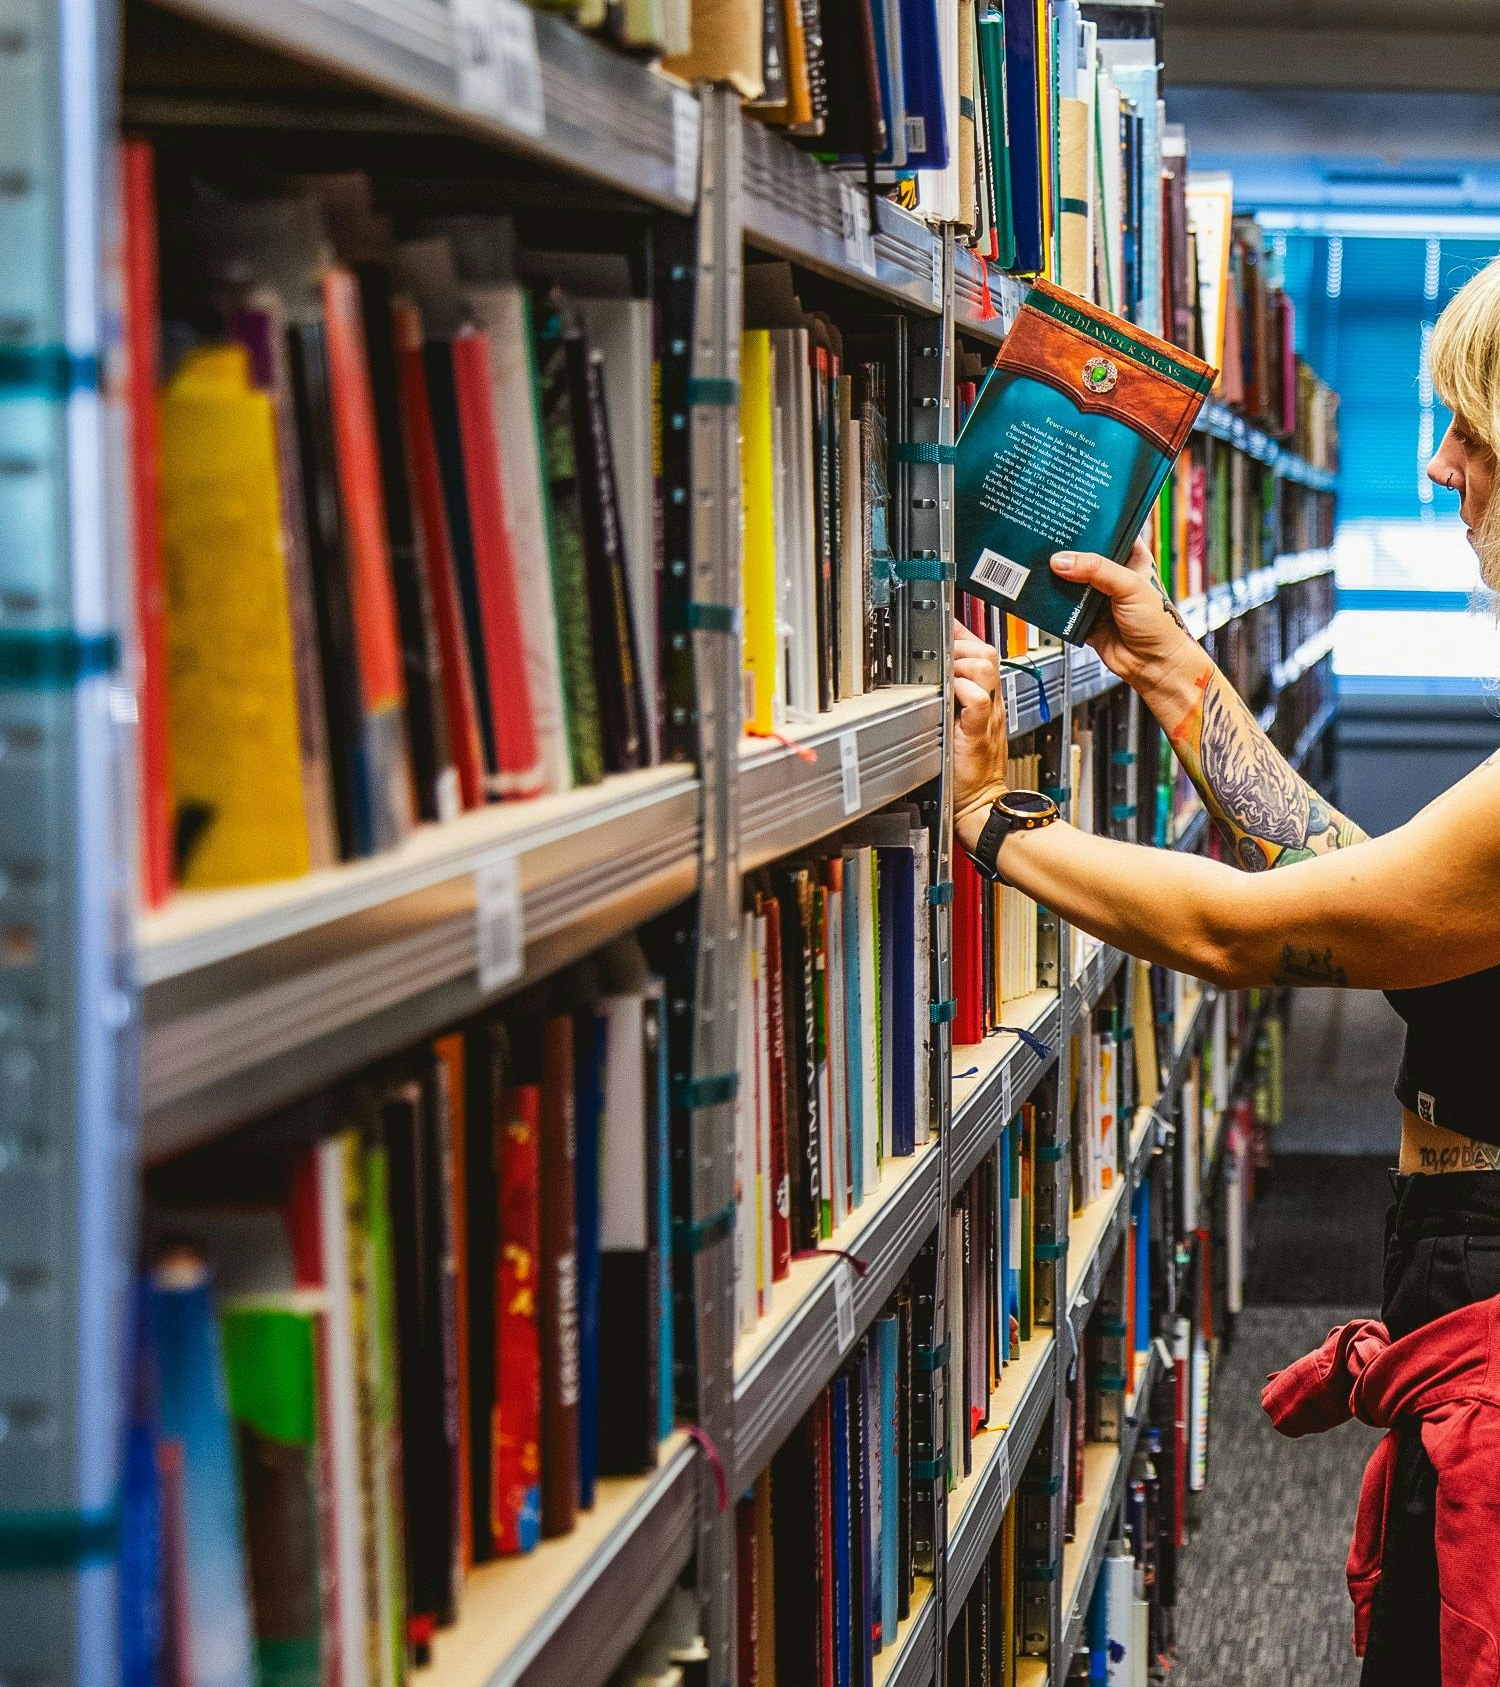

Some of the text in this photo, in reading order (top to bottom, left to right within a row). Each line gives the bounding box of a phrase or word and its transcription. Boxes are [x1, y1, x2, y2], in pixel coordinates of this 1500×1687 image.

[1139, 351, 1181, 377] SAGAS
[1045, 416, 1097, 447] Feuer und Stein
[1053, 437, 1065, 446] Jahr
[1100, 460, 1109, 468] der
[1021, 466, 1032, 475] Jahr
[1040, 457, 1050, 466] und
[1064, 470, 1075, 479] sich
[1080, 459, 1094, 470] Frank
[1024, 495, 1034, 503] und
[1033, 491, 1044, 499] den
[979, 499, 990, 508] und
[1062, 607, 1080, 636] Weltbild
